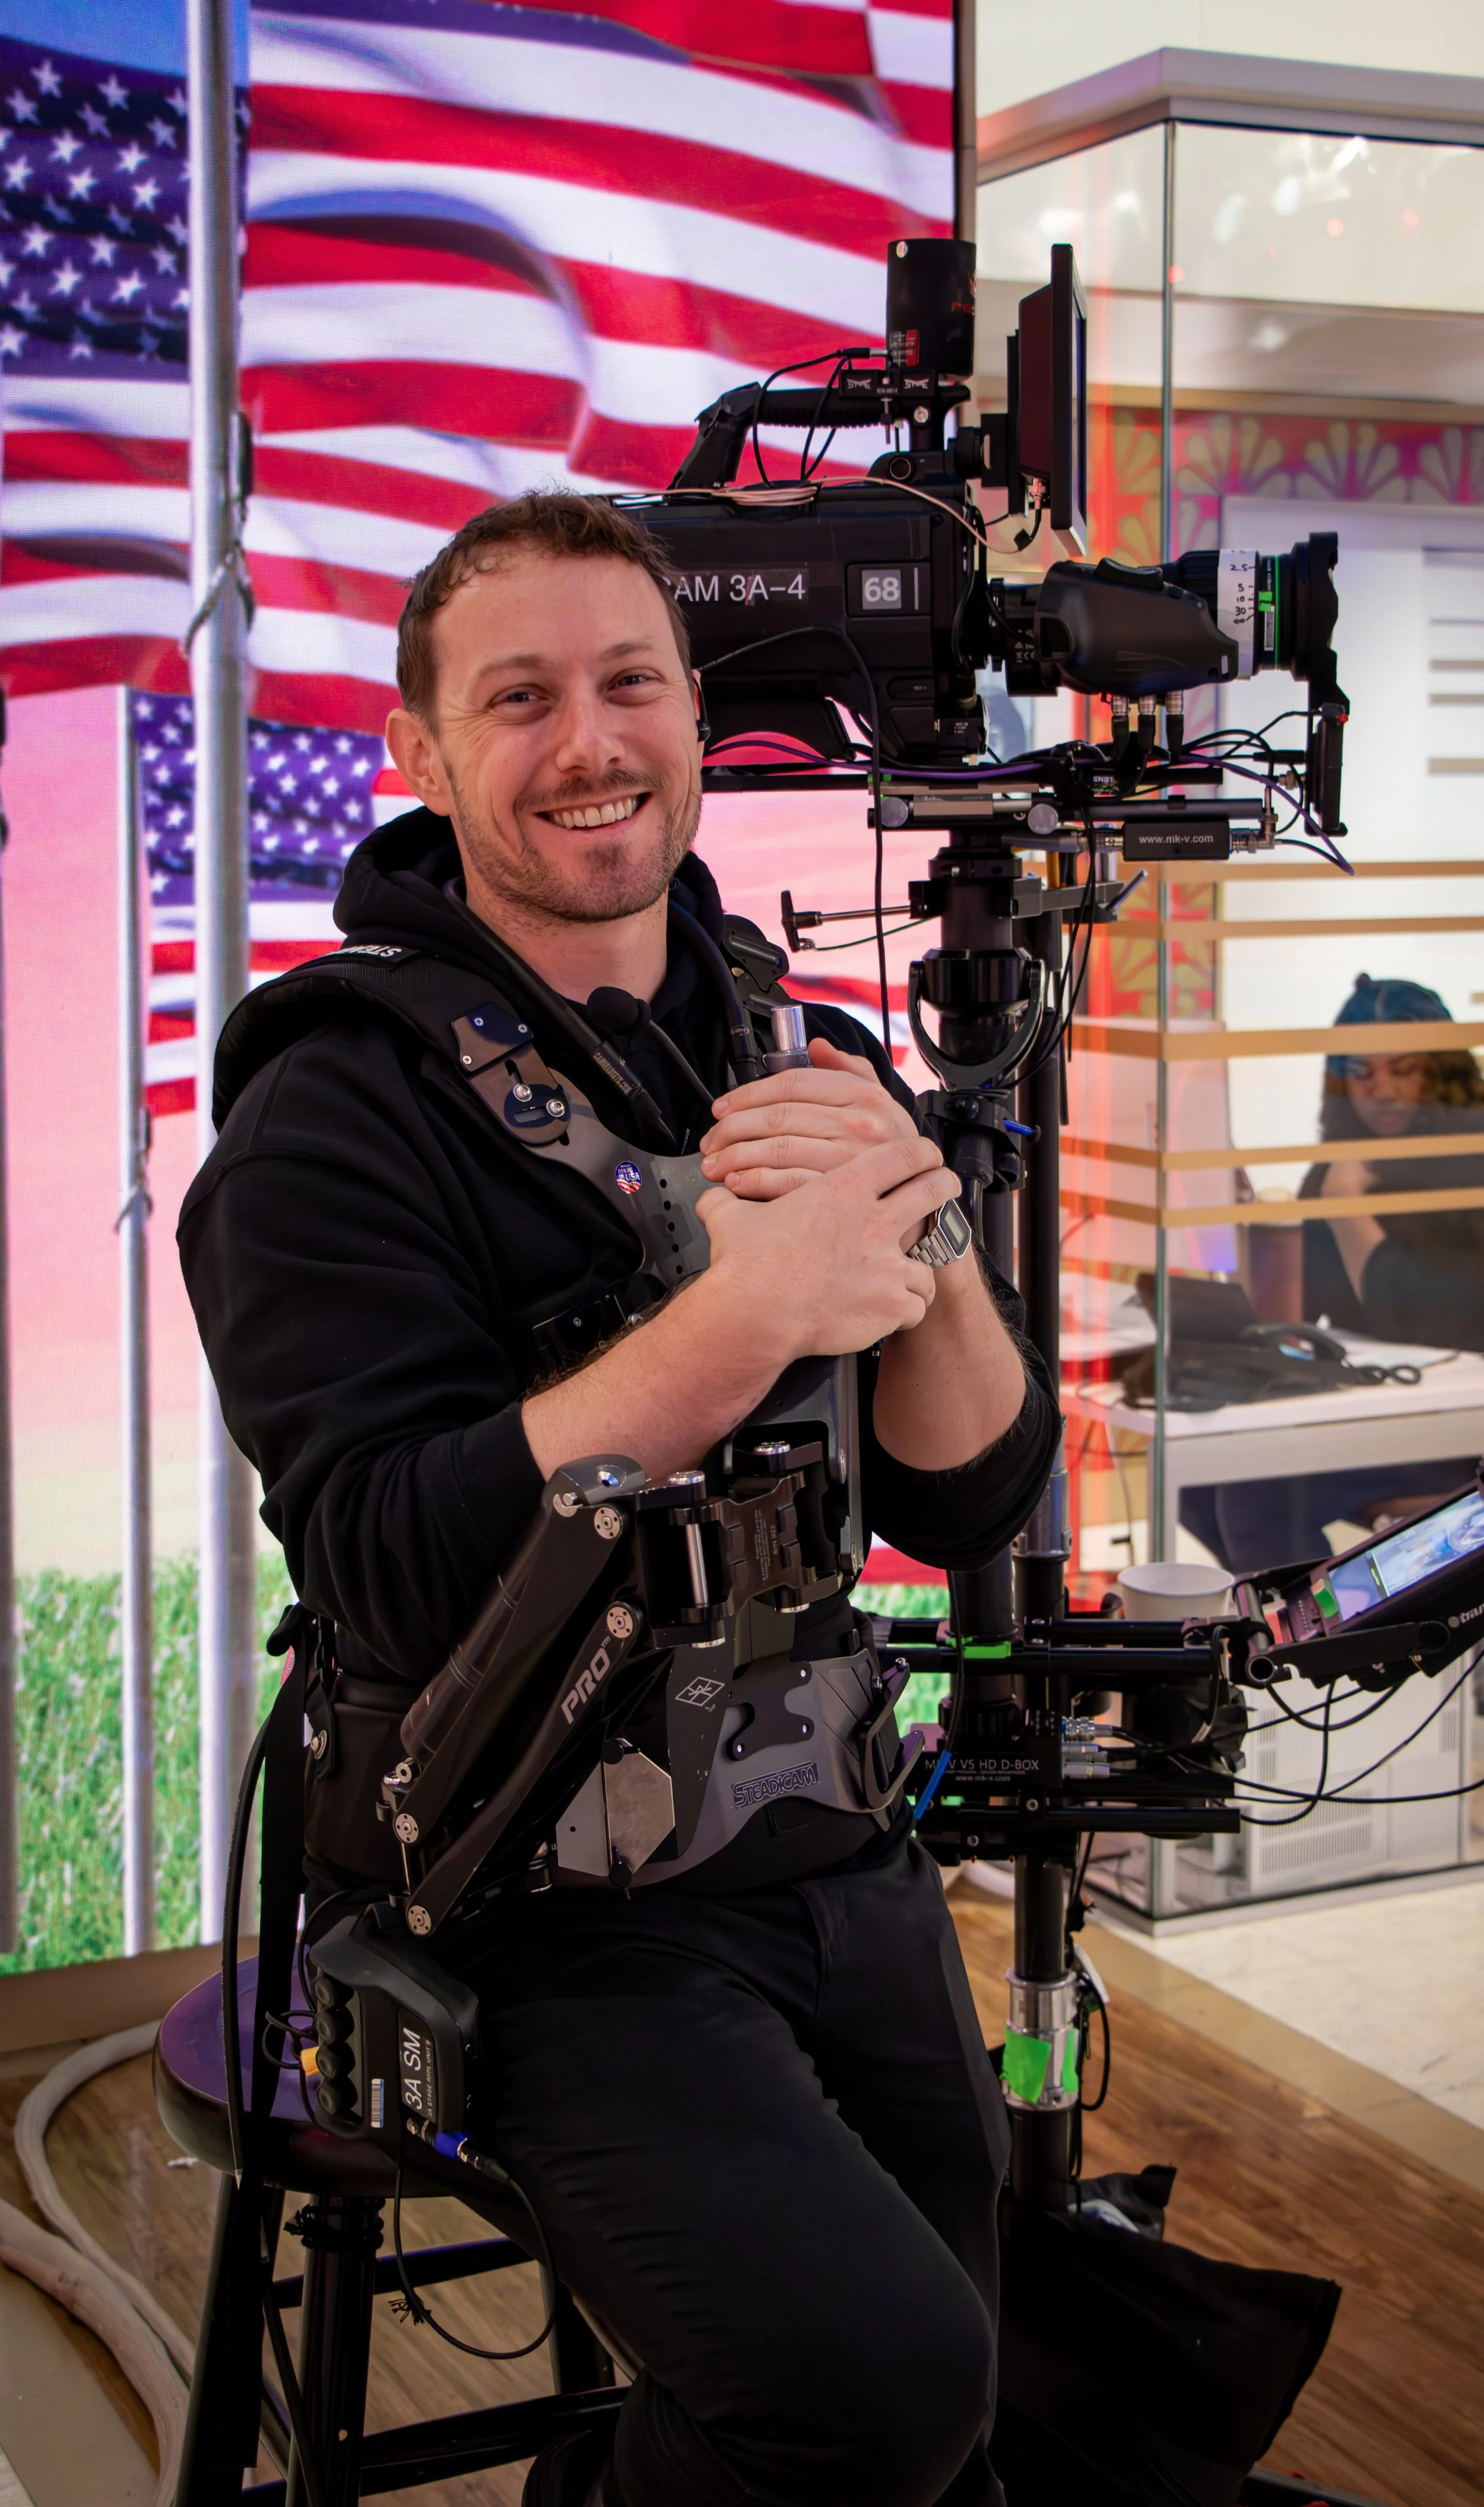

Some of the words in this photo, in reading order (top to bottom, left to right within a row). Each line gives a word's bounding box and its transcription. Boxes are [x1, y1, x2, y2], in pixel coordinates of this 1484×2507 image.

[1230, 564, 1248, 572] 2.5
[662, 575, 719, 602] AM
[864, 577, 899, 602] 68
[1238, 583, 1245, 592] 5
[1235, 606, 1247, 616] 30
[1139, 834, 1214, 844] www.mk-v.com
[625, 1172, 641, 1182] USA
[560, 1647, 611, 1725] PRO
[925, 1759, 956, 1770] MV
[979, 1759, 997, 1770] HD
[1001, 1759, 1039, 1771] D-BOX
[733, 1760, 817, 1808] STEADICAM
[403, 2027, 421, 2071] SM
[404, 2078, 423, 2110] 3A
